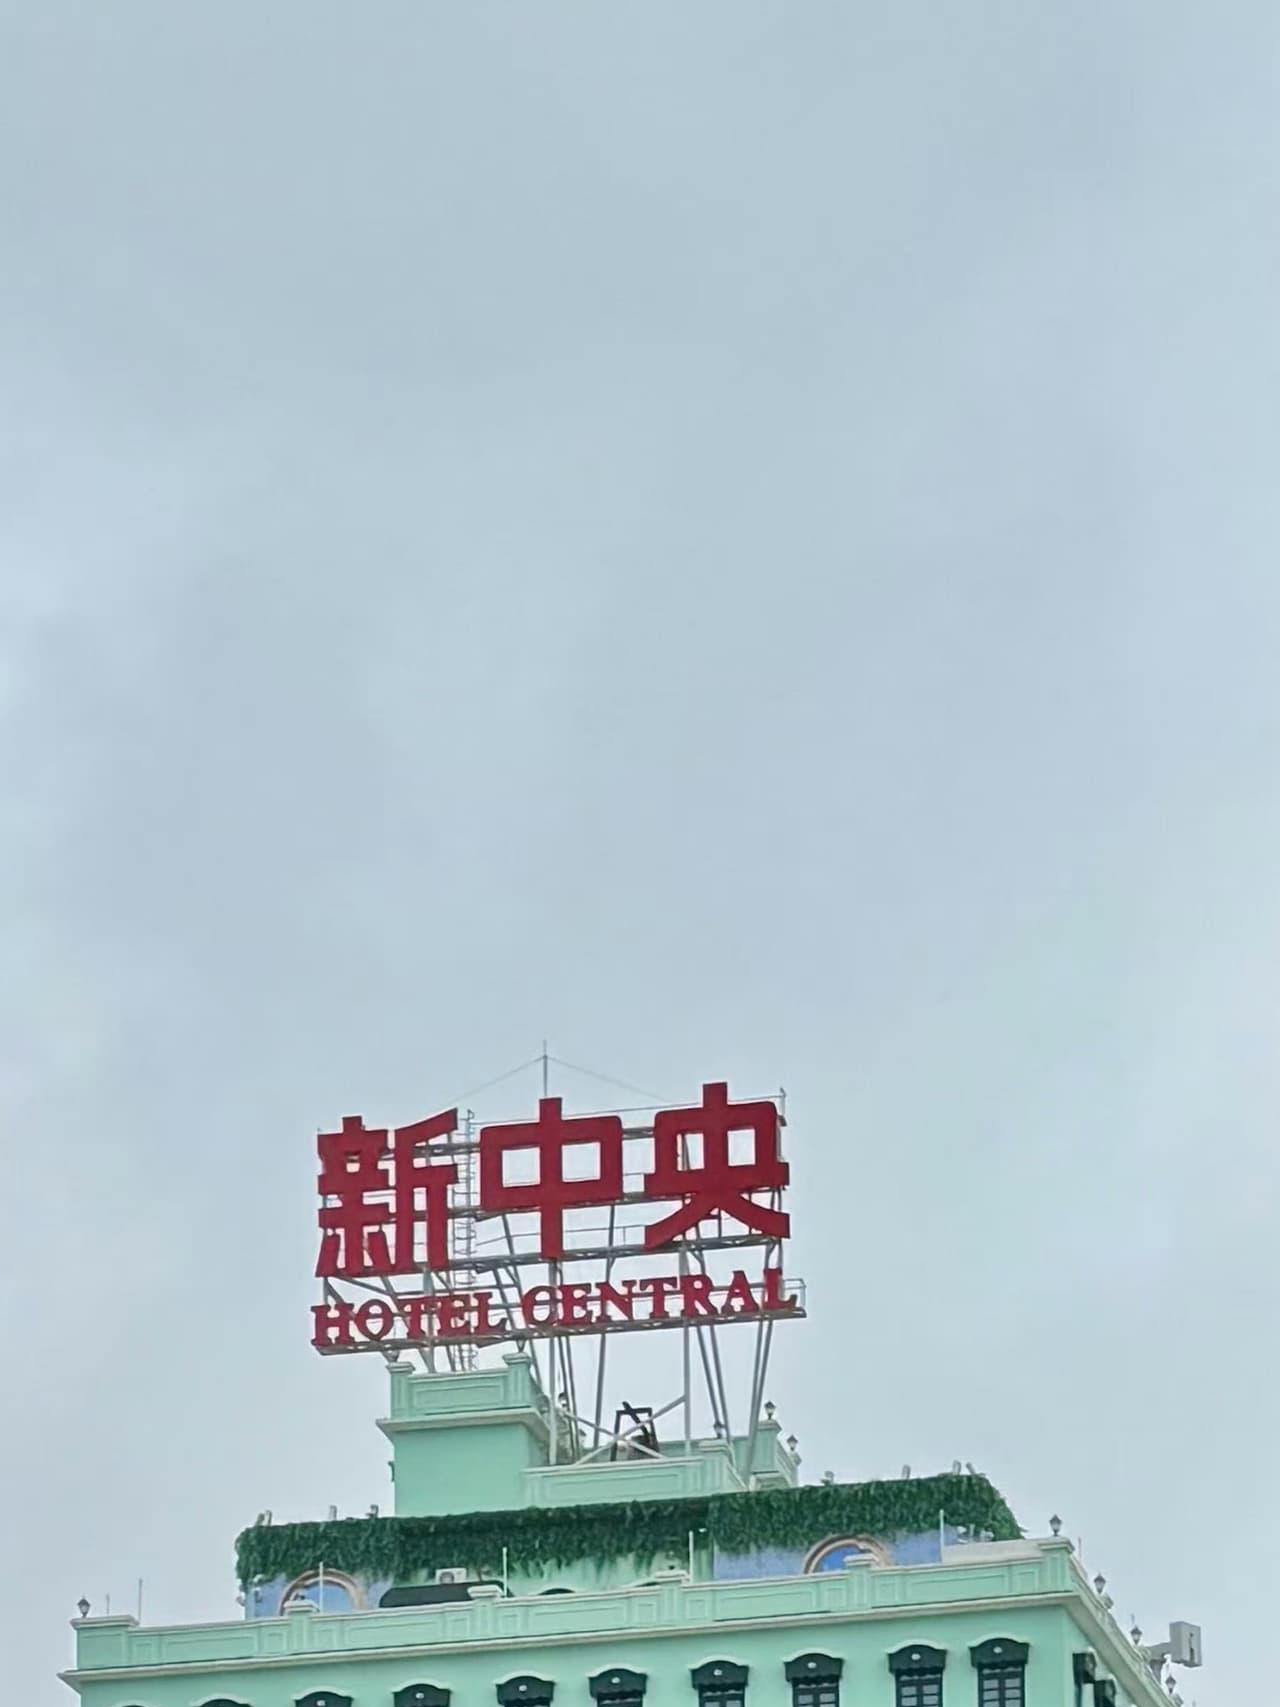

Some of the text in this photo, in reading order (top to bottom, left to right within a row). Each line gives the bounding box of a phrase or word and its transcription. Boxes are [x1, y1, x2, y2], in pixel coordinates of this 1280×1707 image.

[316, 1081, 790, 1278] 新中央
[311, 1267, 798, 1346] HOTEL CENTRAL
